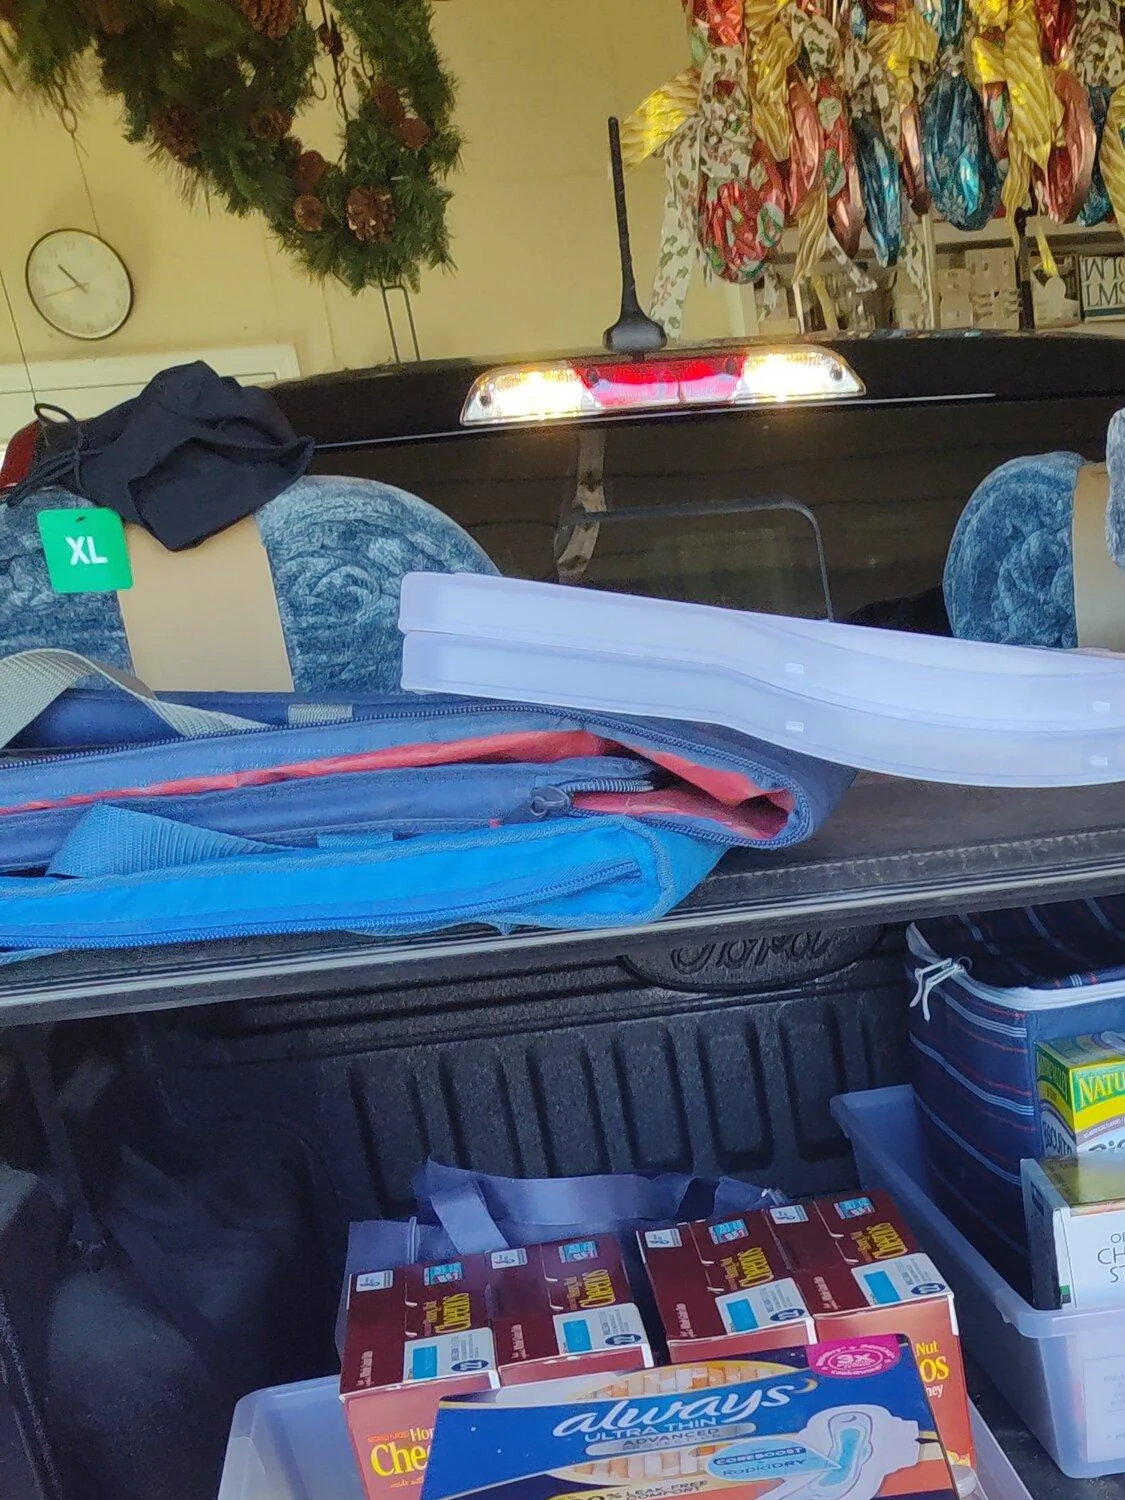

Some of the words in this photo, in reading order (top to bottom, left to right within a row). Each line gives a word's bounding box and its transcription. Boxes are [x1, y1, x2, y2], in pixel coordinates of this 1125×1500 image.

[66, 536, 108, 565] XL
[915, 1340, 939, 1357] Nut
[919, 1356, 950, 1383] os
[553, 1384, 796, 1438] always
[584, 1427, 657, 1443] ULTRA
[666, 1417, 717, 1433] THIN
[623, 1428, 719, 1447] ADVANCED
